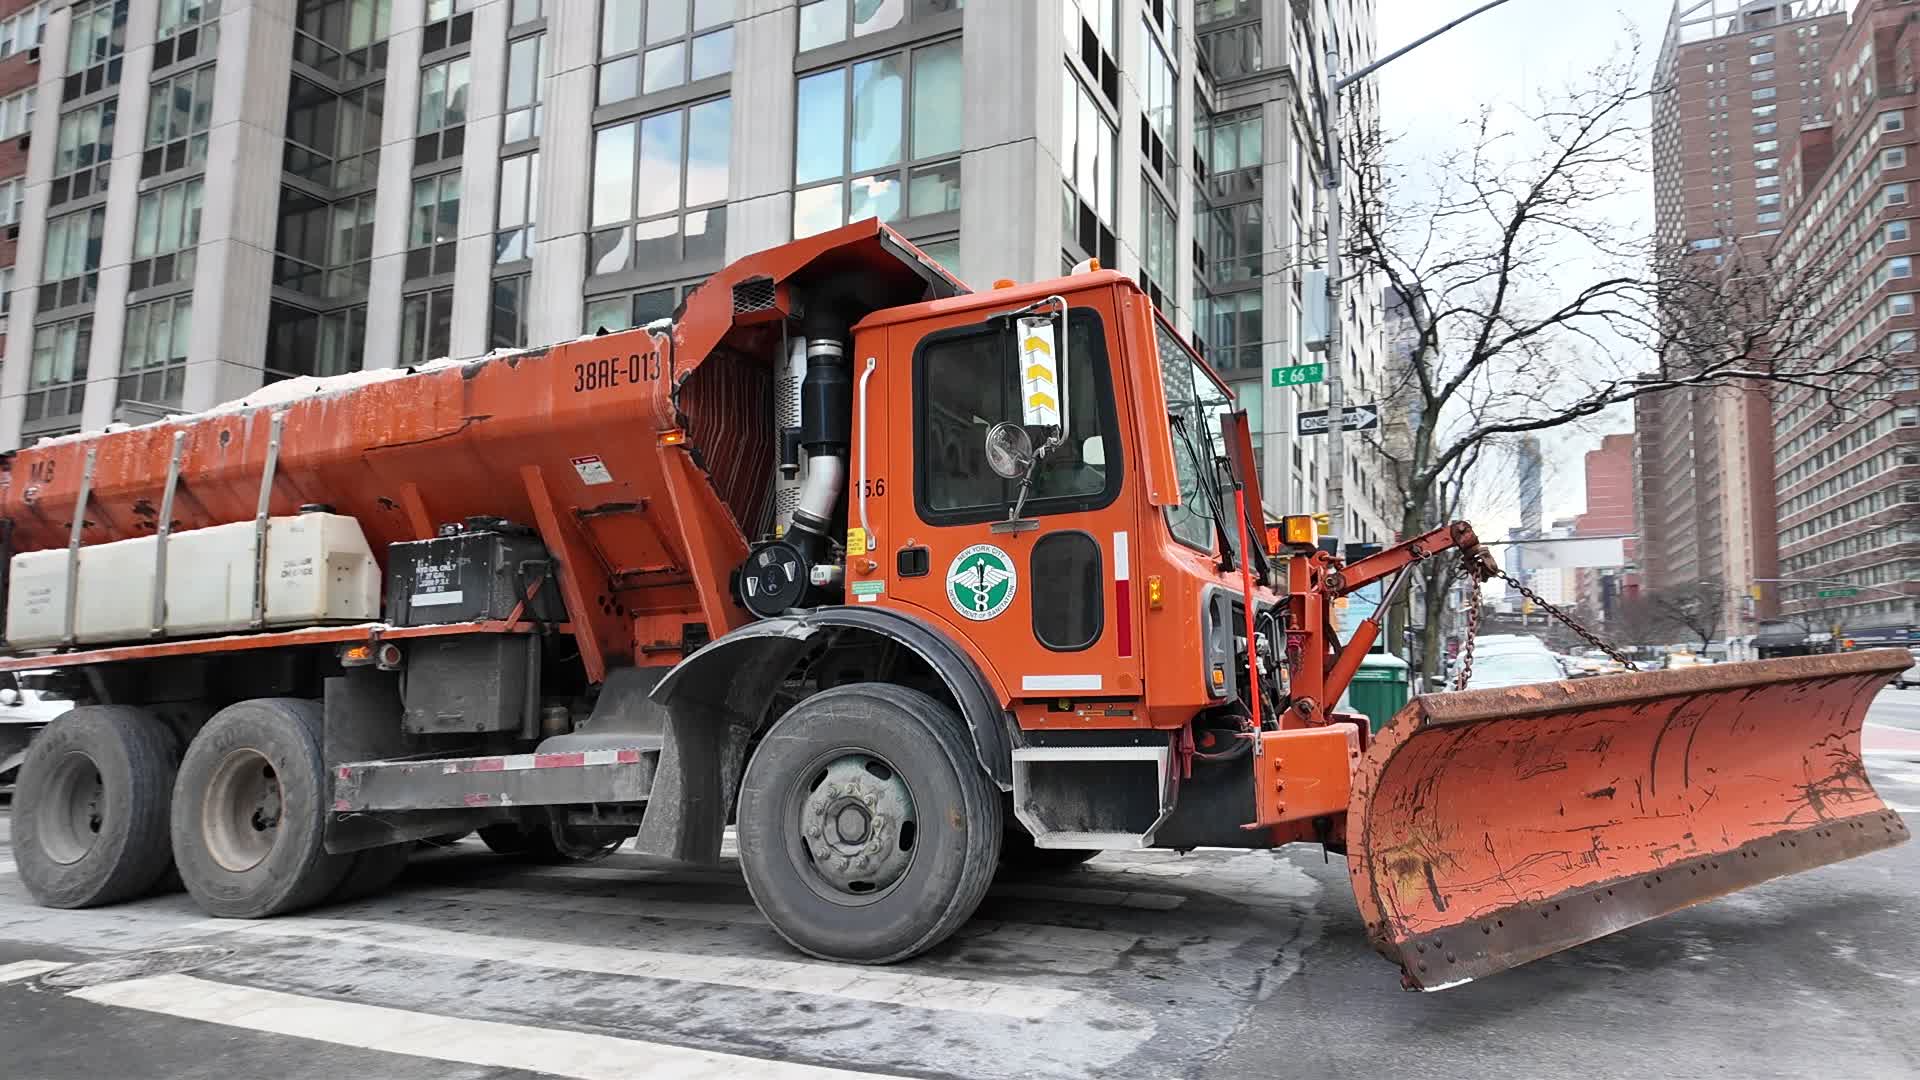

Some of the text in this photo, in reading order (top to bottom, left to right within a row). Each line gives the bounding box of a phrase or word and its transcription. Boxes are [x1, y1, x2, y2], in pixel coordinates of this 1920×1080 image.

[574, 351, 660, 393] 38AE-013
[1278, 370, 1286, 384] E
[1290, 368, 1305, 383] 66
[1303, 416, 1328, 429] ONE
[855, 477, 885, 499] 15.6
[957, 545, 1006, 561] NEW YORK CITY
[948, 589, 977, 618] DEPARTMENT
[986, 584, 1015, 617] SANITATION
